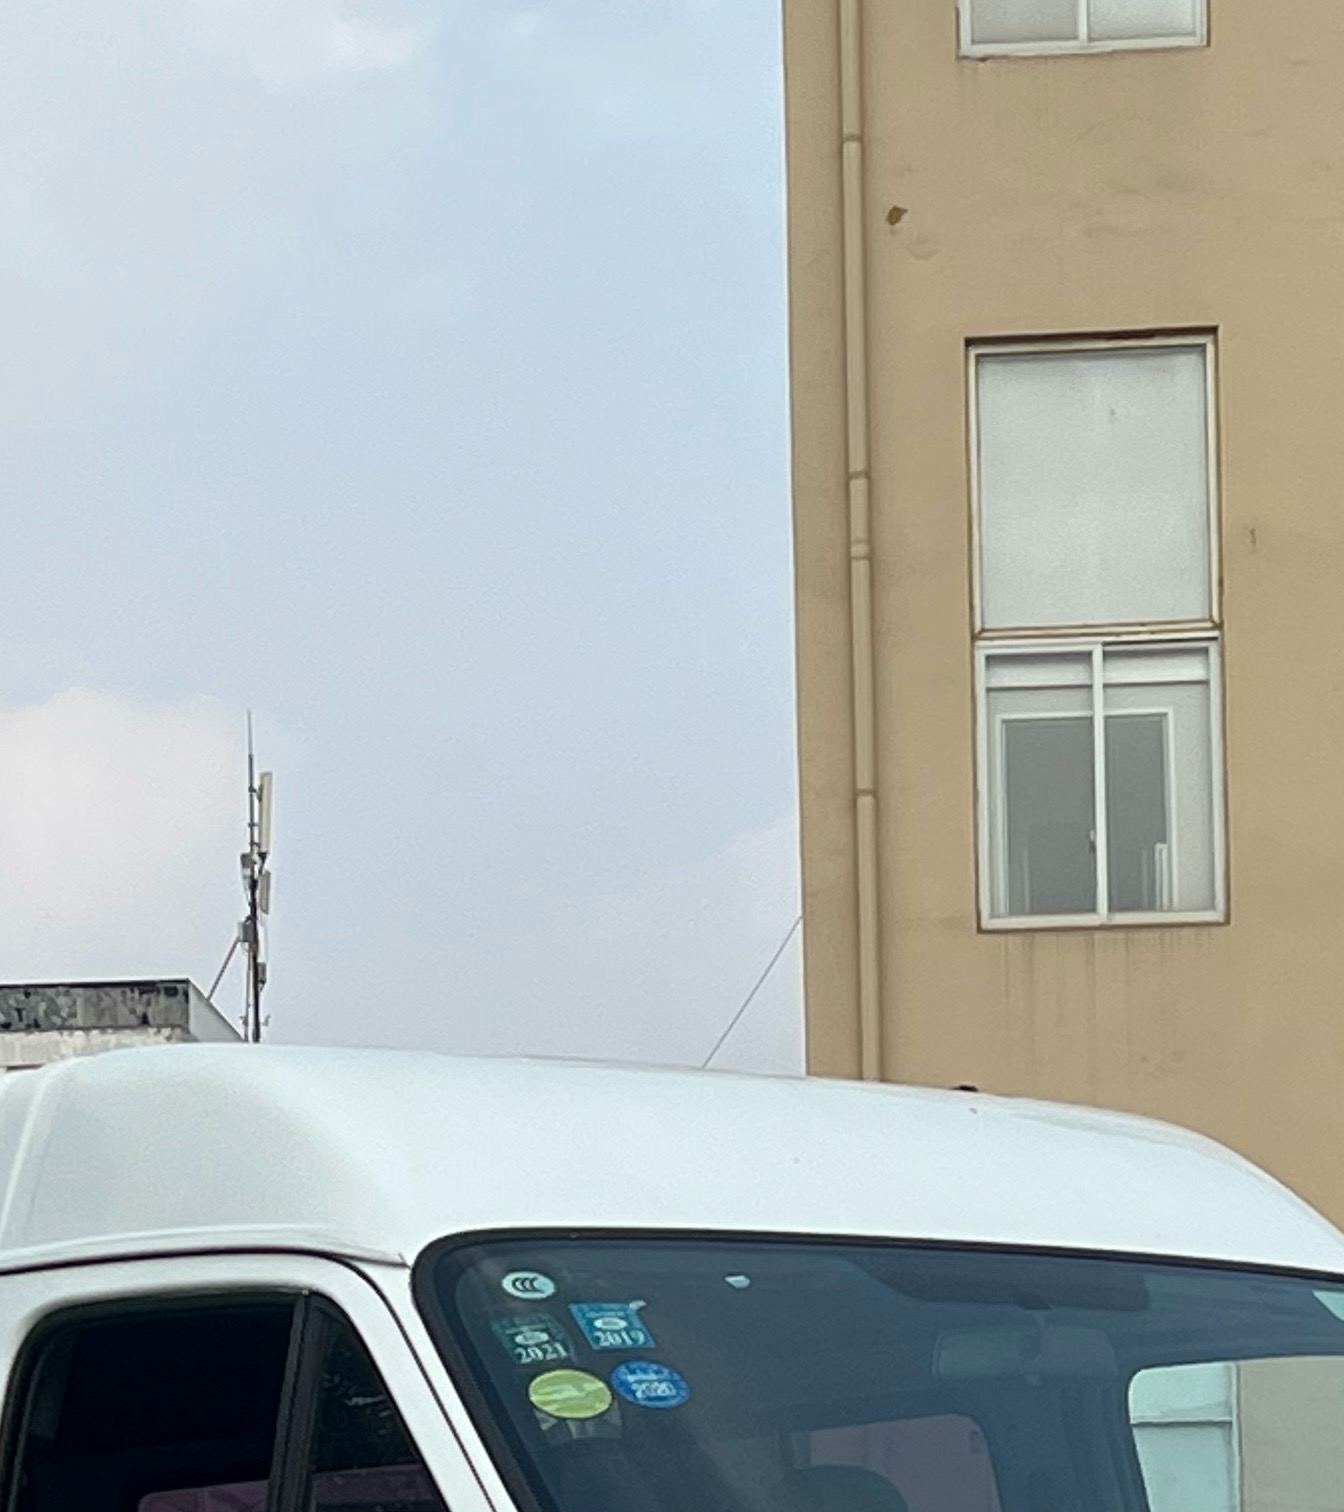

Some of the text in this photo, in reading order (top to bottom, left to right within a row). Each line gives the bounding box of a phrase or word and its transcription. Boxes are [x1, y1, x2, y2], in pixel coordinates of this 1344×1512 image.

[594, 1330, 645, 1346] 2019
[515, 1343, 567, 1364] 2021
[631, 1382, 676, 1399] 2020
